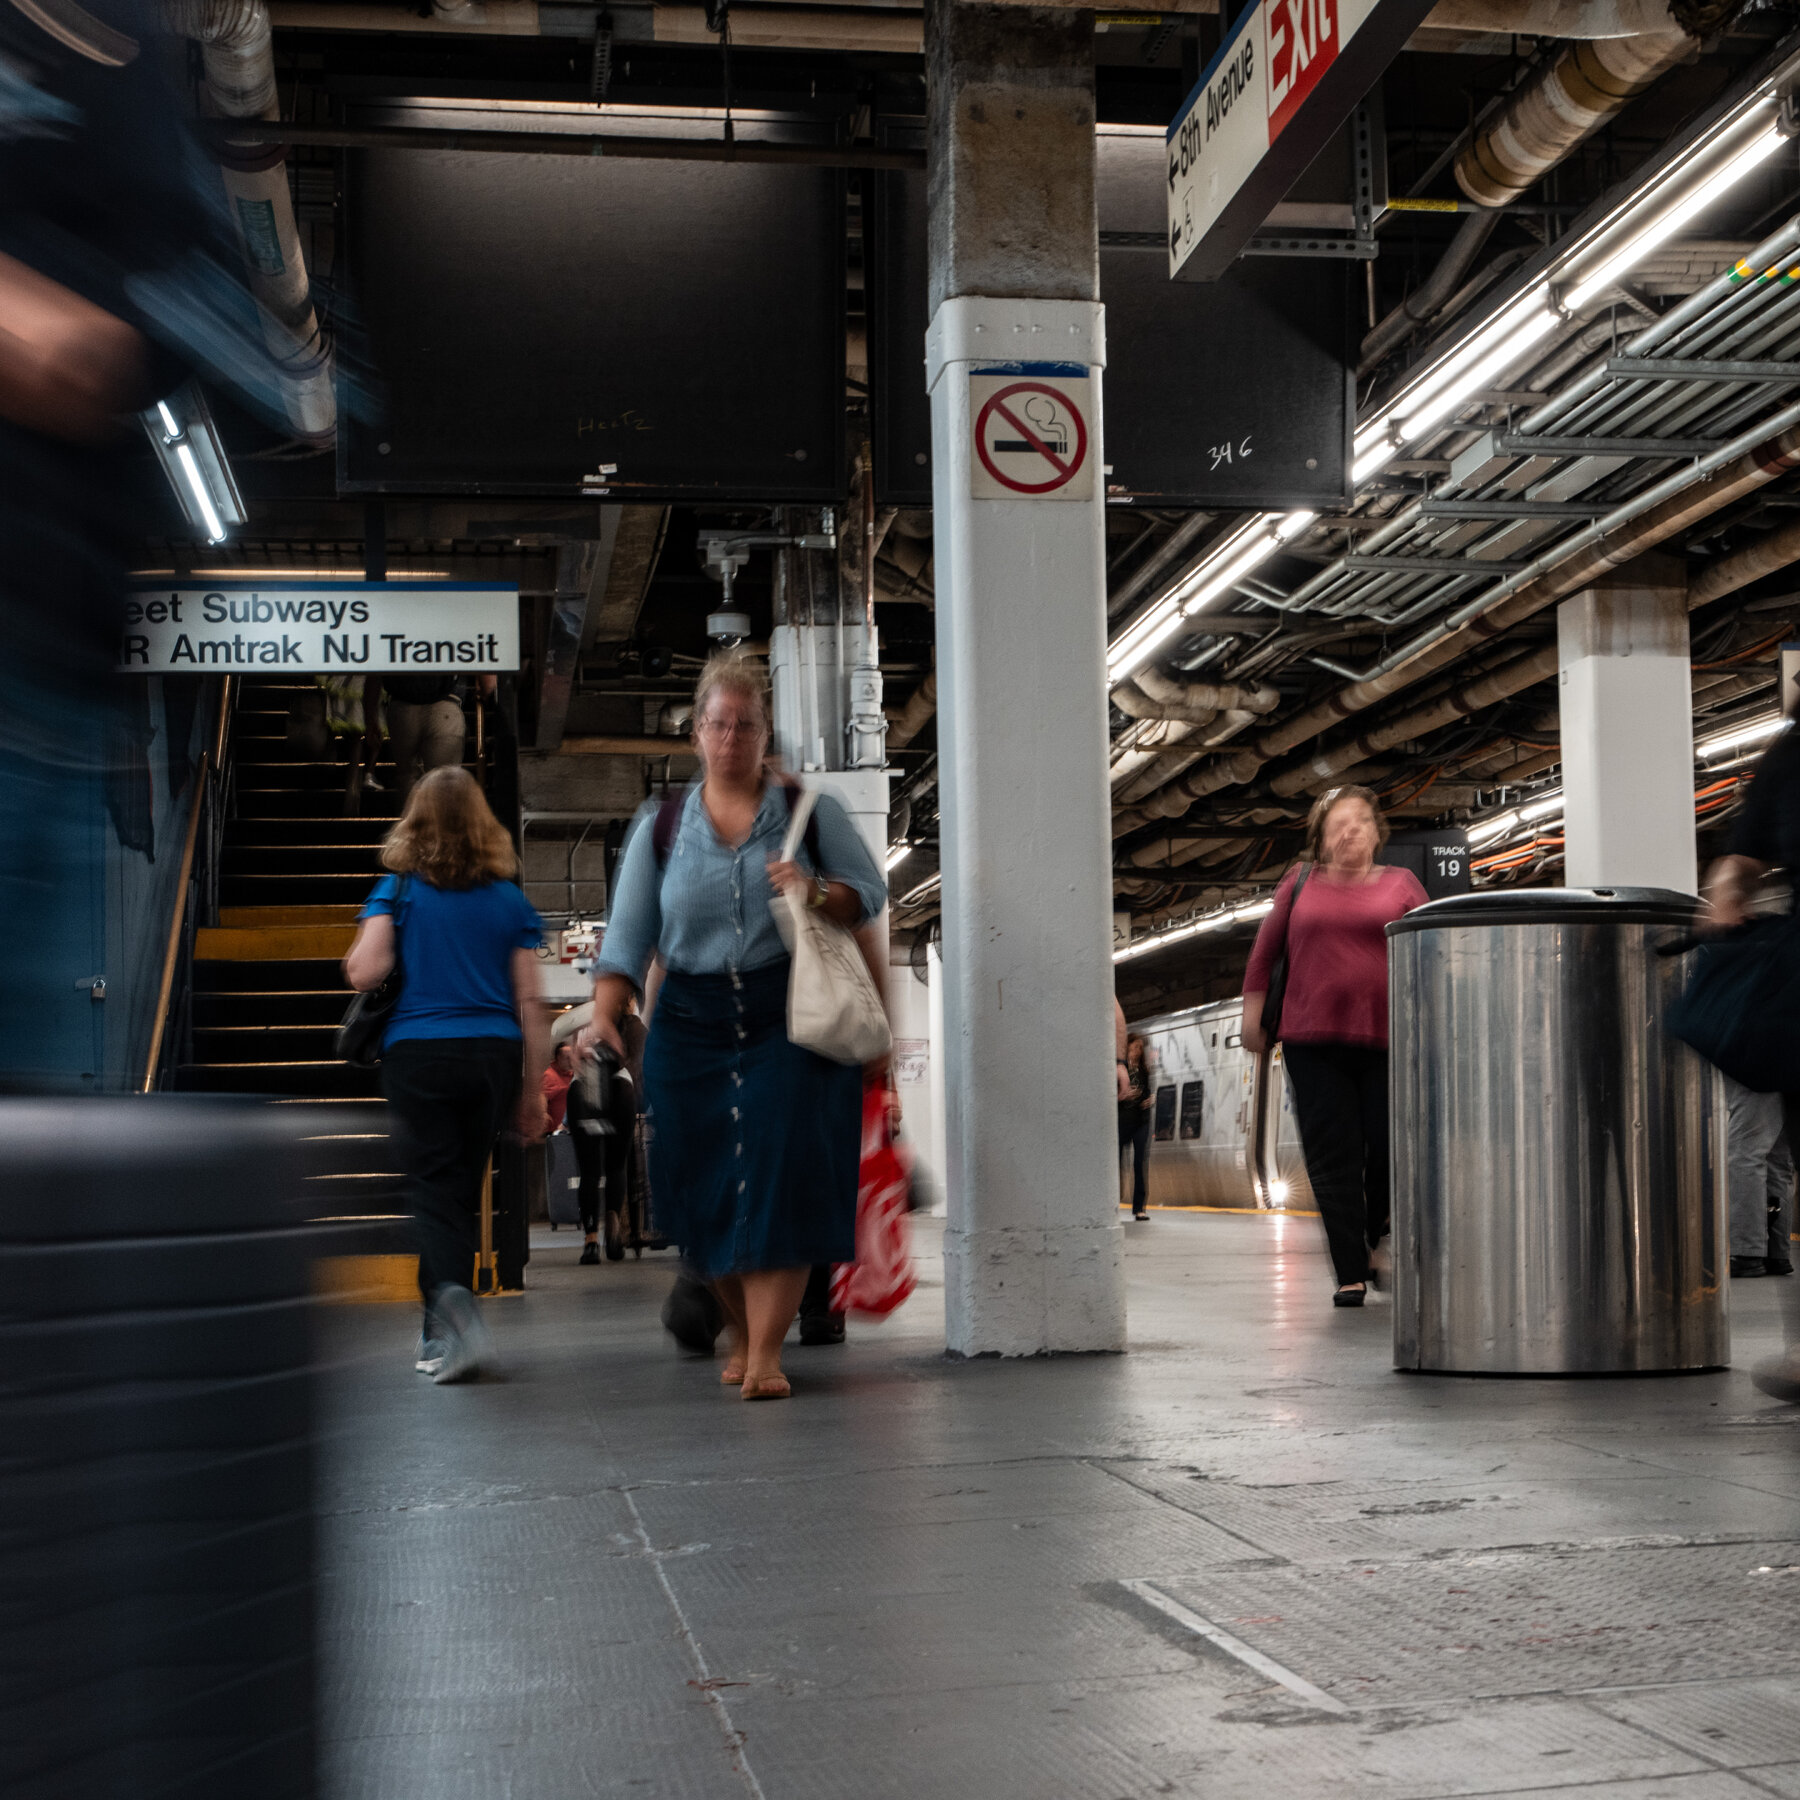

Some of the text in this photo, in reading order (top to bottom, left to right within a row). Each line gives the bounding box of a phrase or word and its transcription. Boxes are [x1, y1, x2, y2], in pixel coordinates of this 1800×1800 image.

[1179, 38, 1255, 177] 8th Avenue
[202, 593, 368, 630] Subways
[170, 634, 303, 664] Amtrak
[323, 634, 369, 663] NJ
[378, 634, 498, 663] Transit
[1431, 846, 1466, 856] TRACK
[1437, 859, 1460, 877] 19
